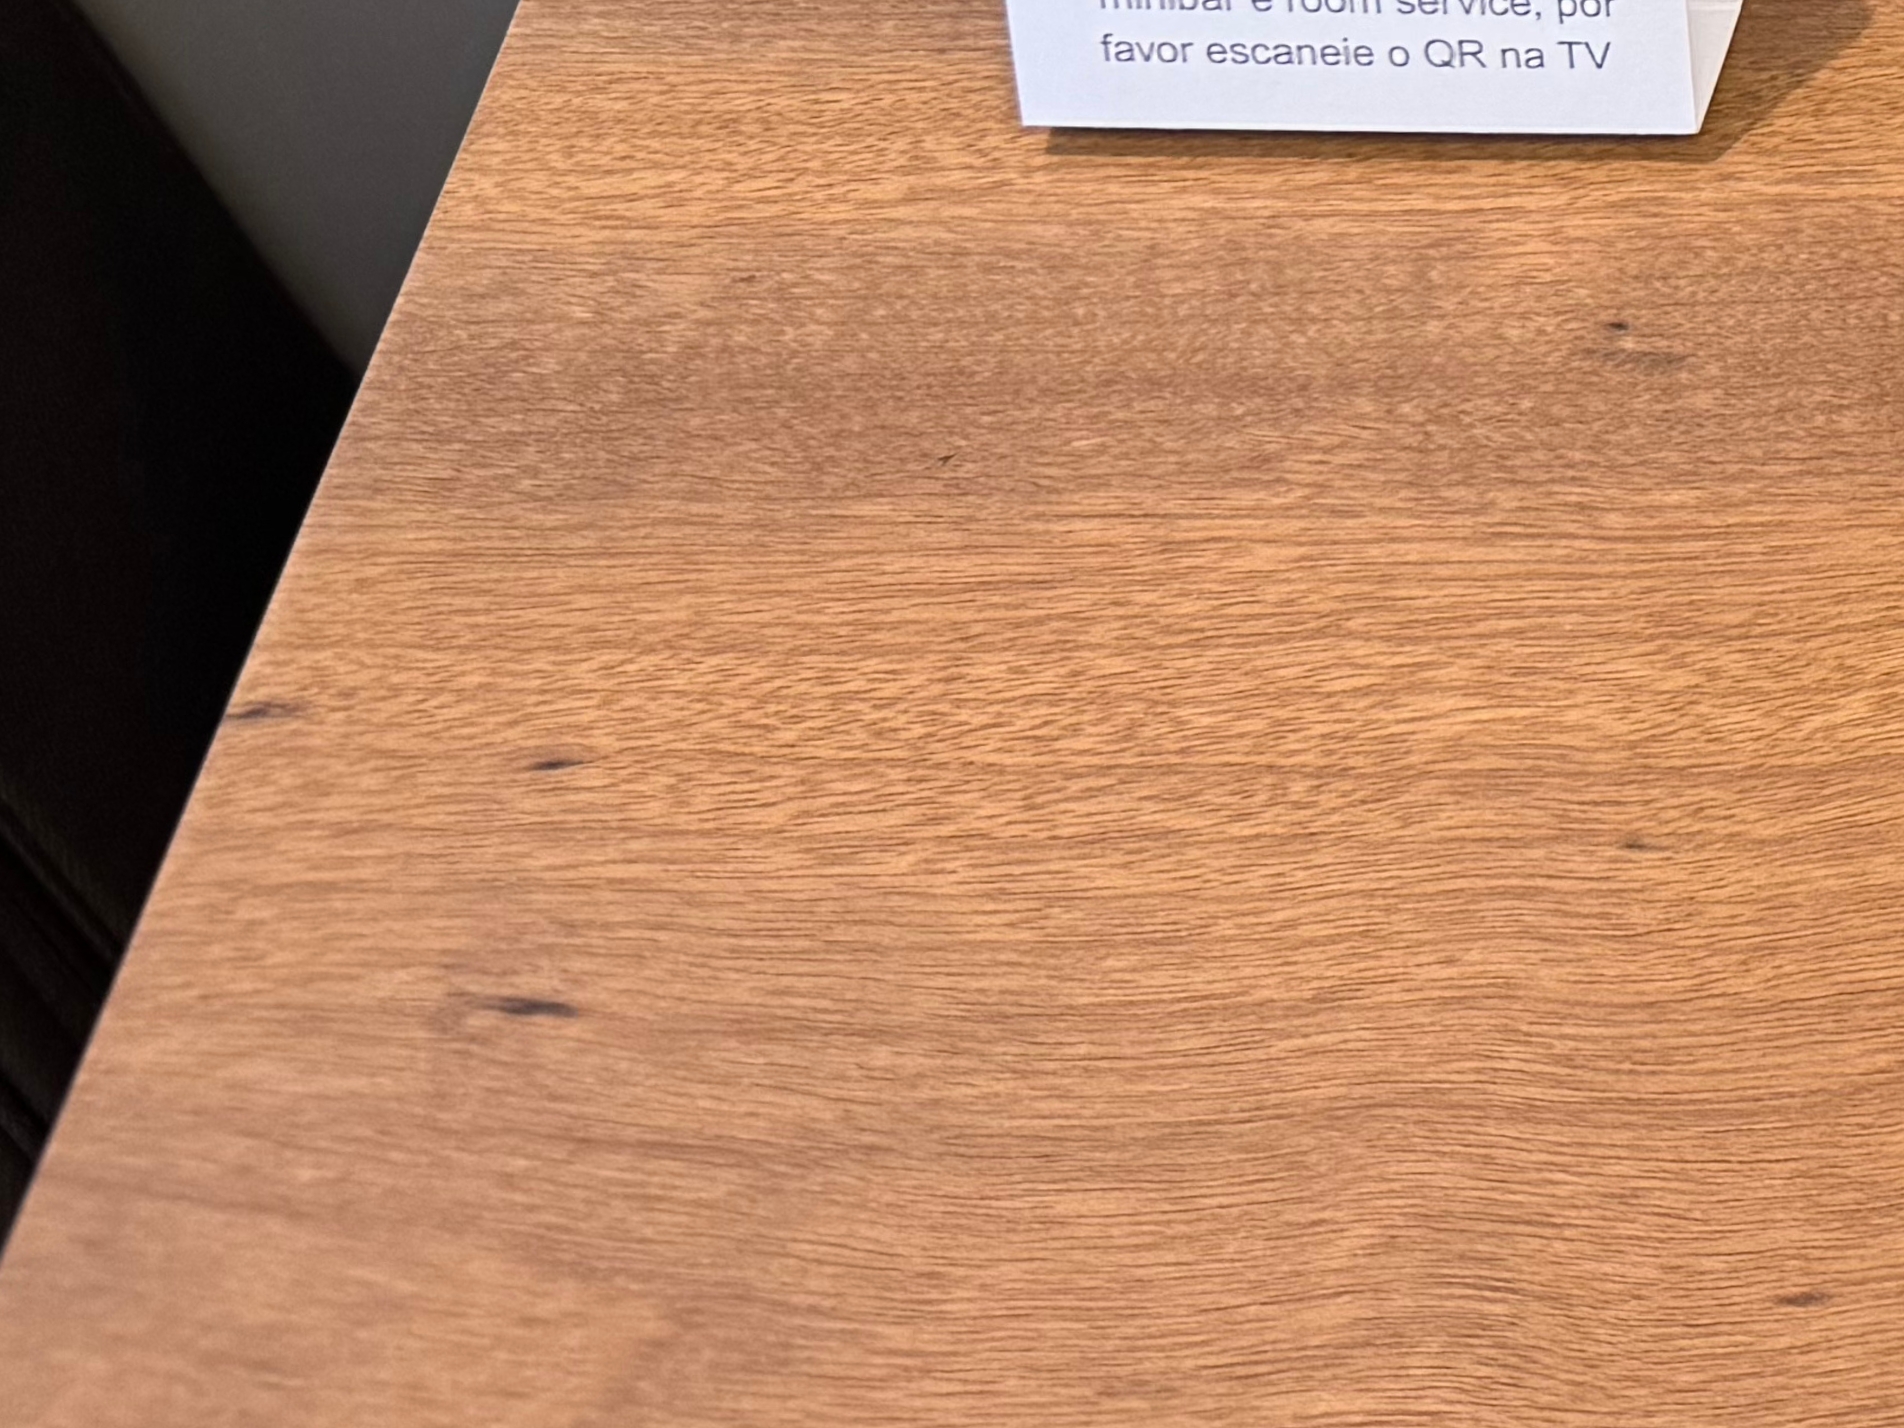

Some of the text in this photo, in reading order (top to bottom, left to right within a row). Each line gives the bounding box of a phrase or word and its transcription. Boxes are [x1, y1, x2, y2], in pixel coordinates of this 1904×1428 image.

[1100, 32, 1612, 70] favor escaneie o QR na TV
